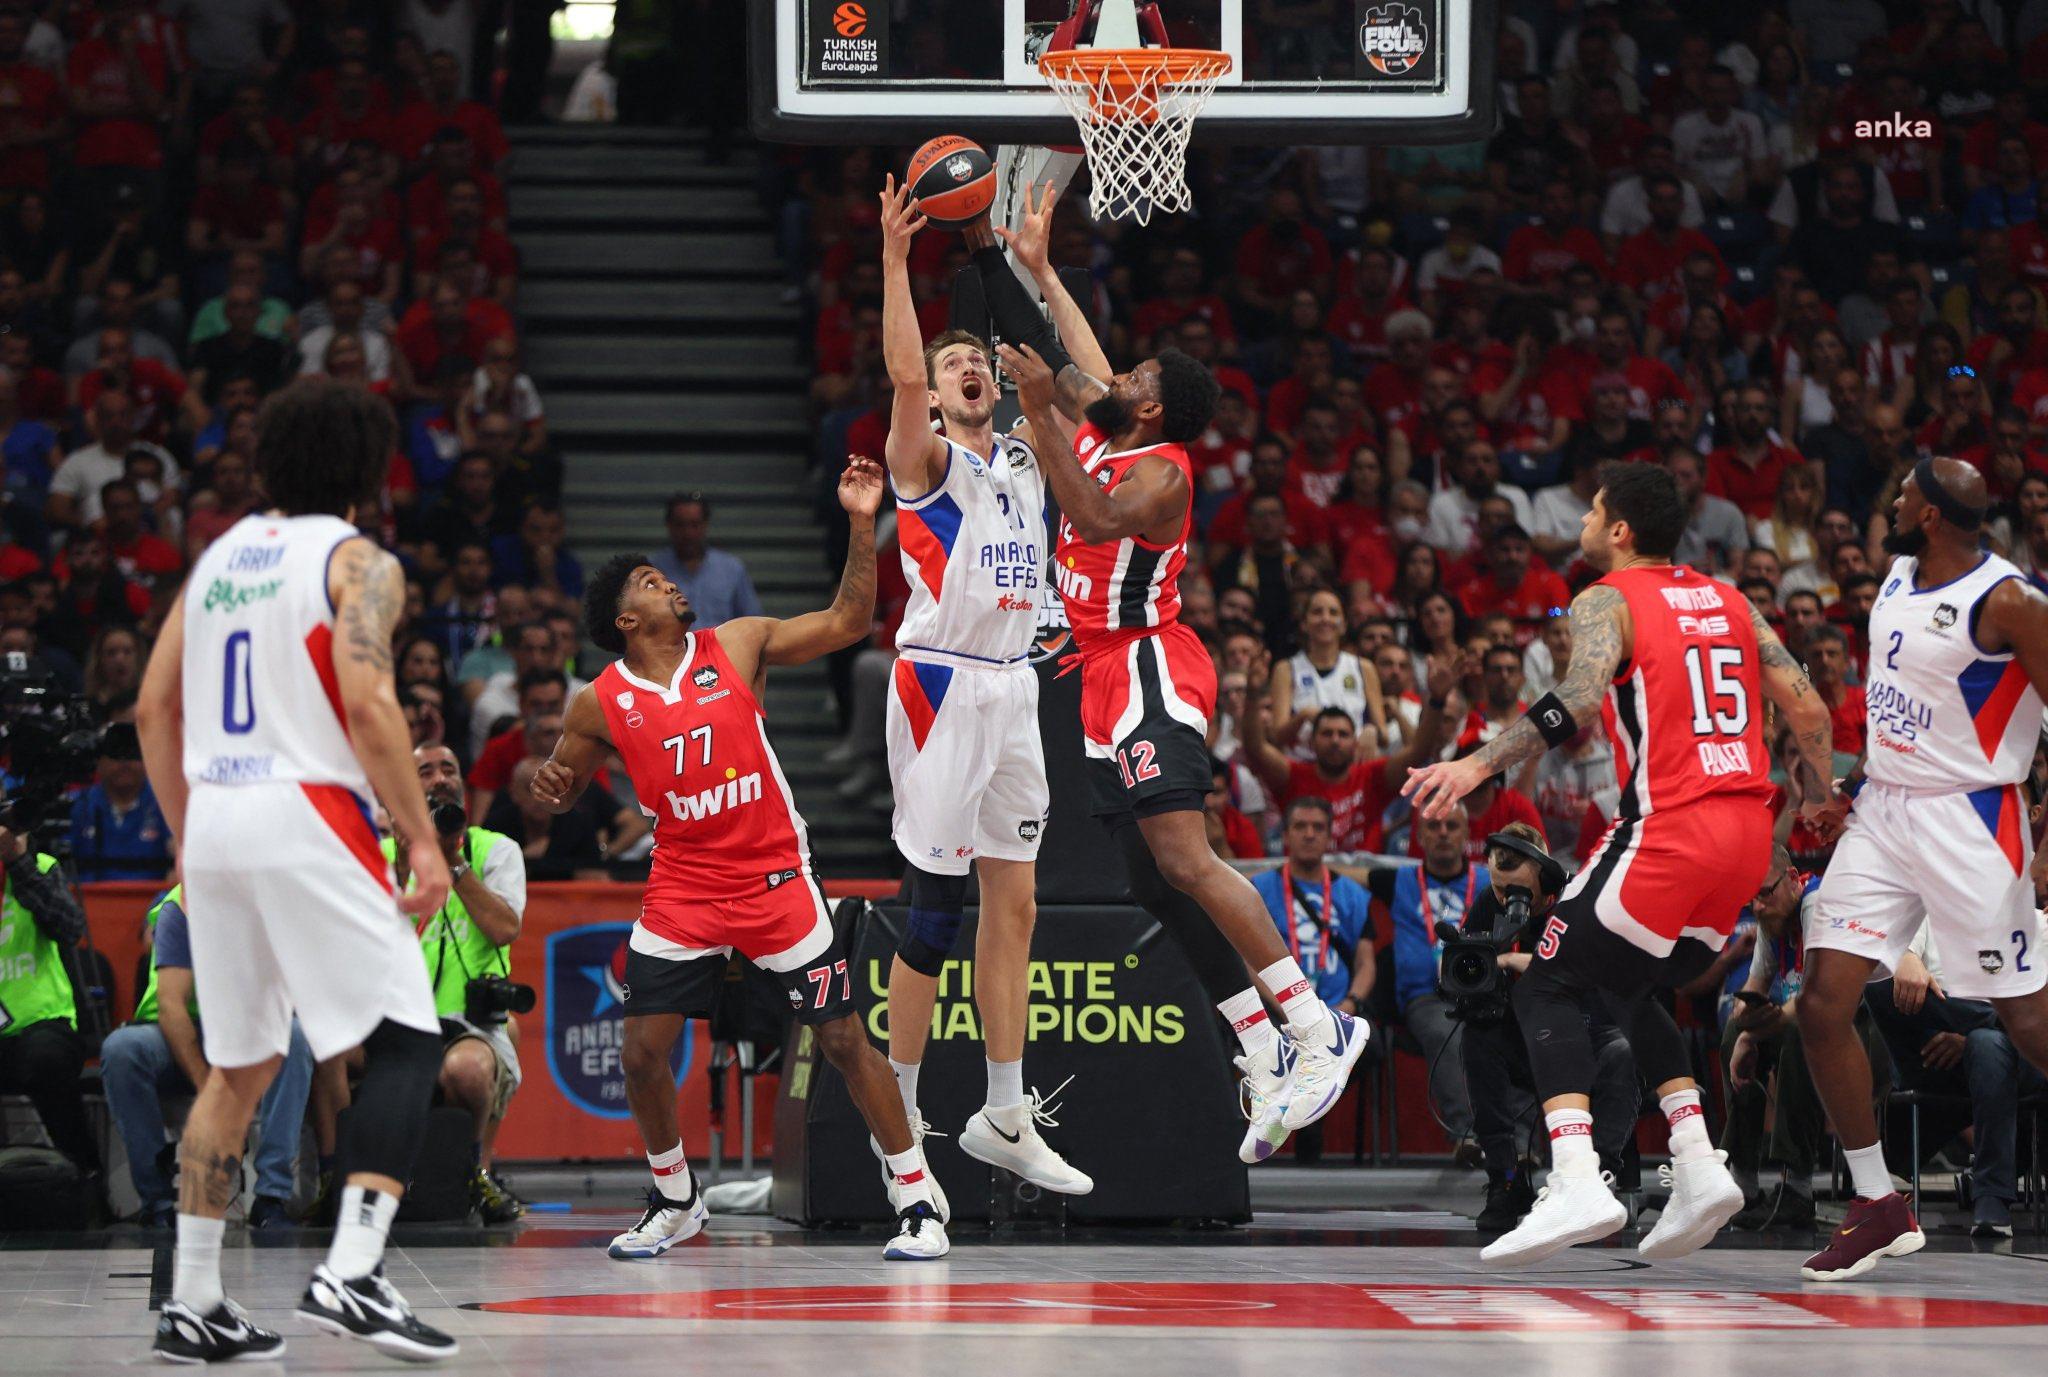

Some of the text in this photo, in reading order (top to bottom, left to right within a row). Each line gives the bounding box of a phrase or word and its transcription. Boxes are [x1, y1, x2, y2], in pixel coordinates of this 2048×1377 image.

[823, 39, 877, 50] TURKISH
[1365, 19, 1420, 40] FINAL
[1365, 39, 1424, 52] FOUR
[821, 62, 878, 74] EuroLeague
[822, 51, 878, 61] AIRLINES
[1887, 631, 1904, 670] 2
[222, 629, 256, 735] 0
[1684, 645, 1749, 736] 15
[661, 723, 713, 776] 77
[1117, 740, 1162, 789] 12
[664, 767, 763, 822] bwin
[2011, 930, 2031, 972] 2
[807, 958, 850, 1009] 77
[869, 959, 1115, 1000] UTIATE
[565, 1019, 624, 1055] ANAD
[868, 1001, 1185, 1044] CAPIONS
[1232, 1020, 1252, 1032] SA
[582, 1051, 625, 1076] EF
[1559, 1124, 1590, 1136] GSA
[670, 1160, 686, 1174] GS
